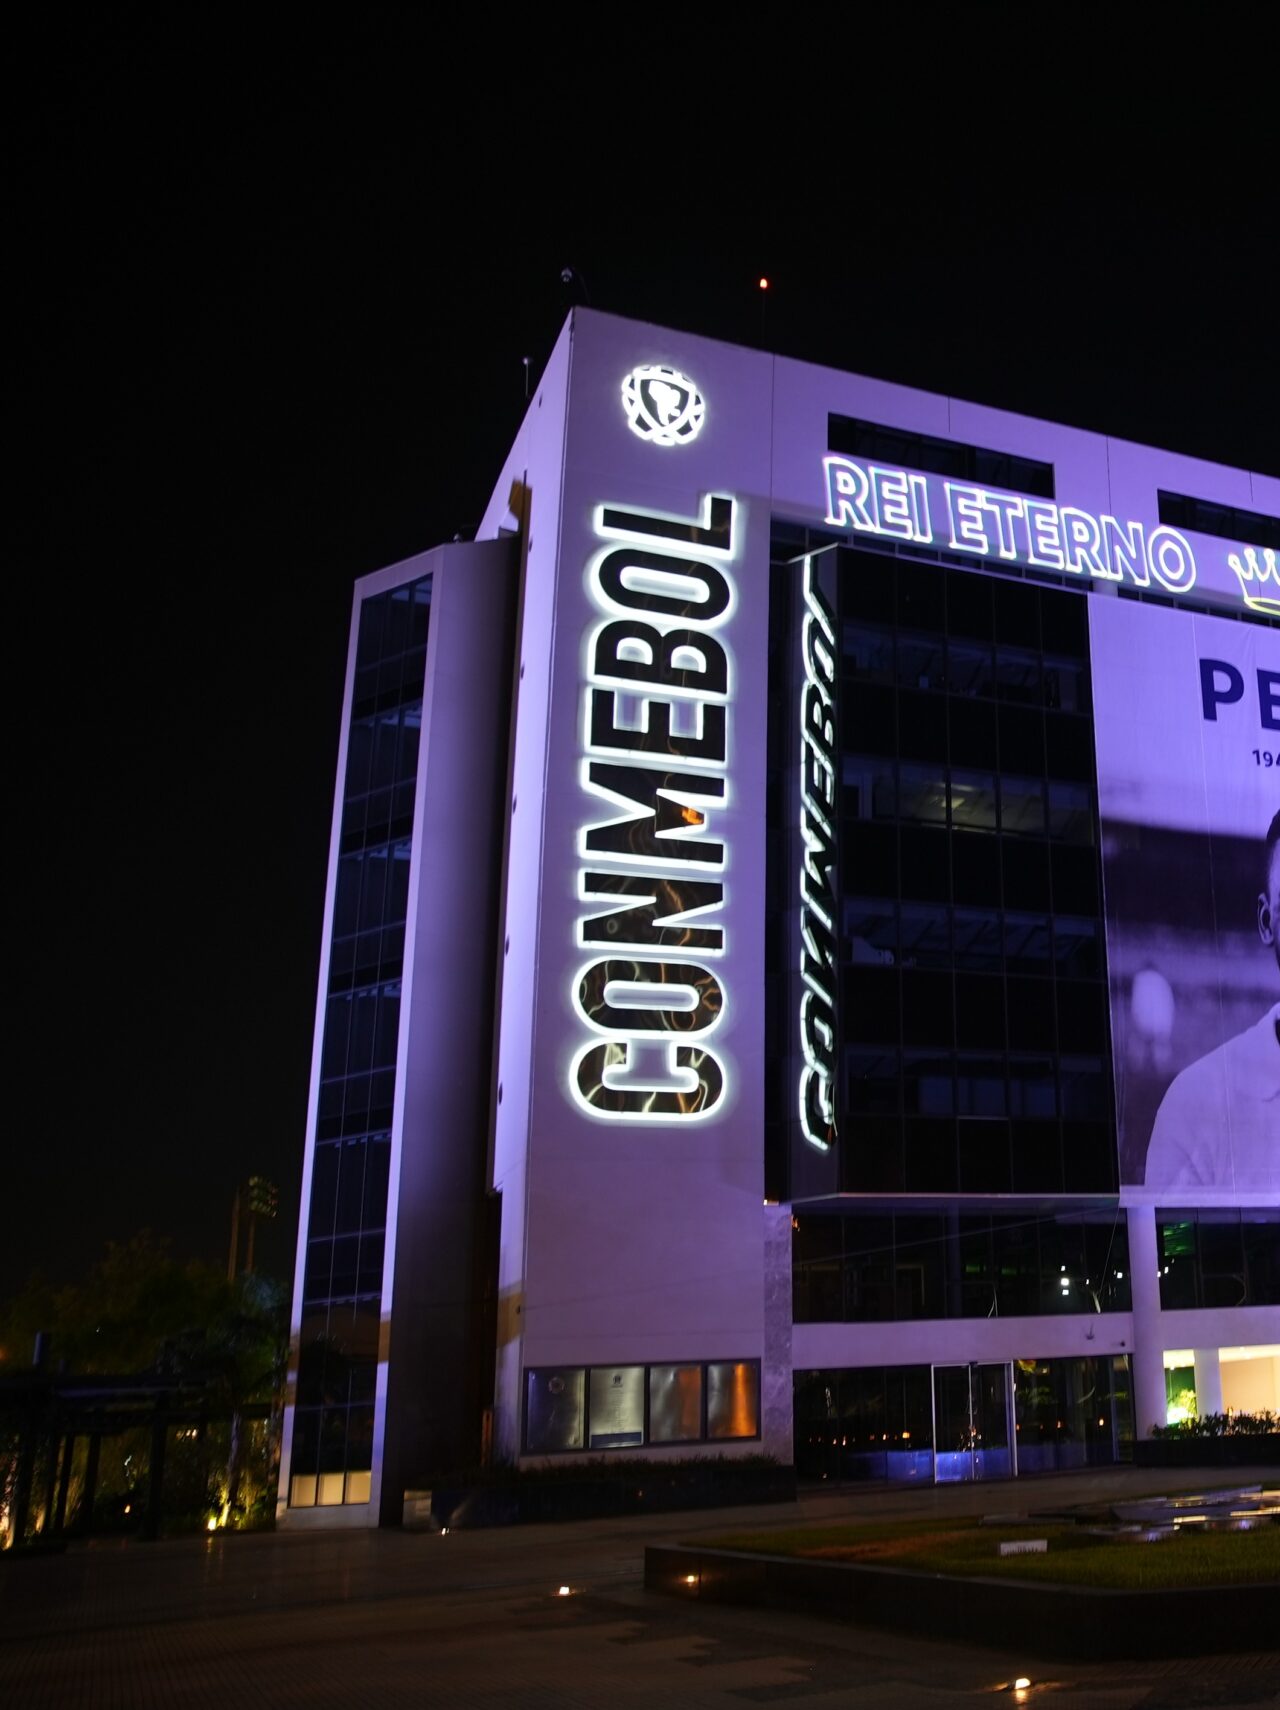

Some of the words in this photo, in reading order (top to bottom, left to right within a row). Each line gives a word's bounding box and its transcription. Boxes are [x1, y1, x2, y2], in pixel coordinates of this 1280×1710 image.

[822, 455, 934, 545] REI
[944, 481, 1198, 592] ETERNO
[569, 492, 740, 1123] CONMEBOL
